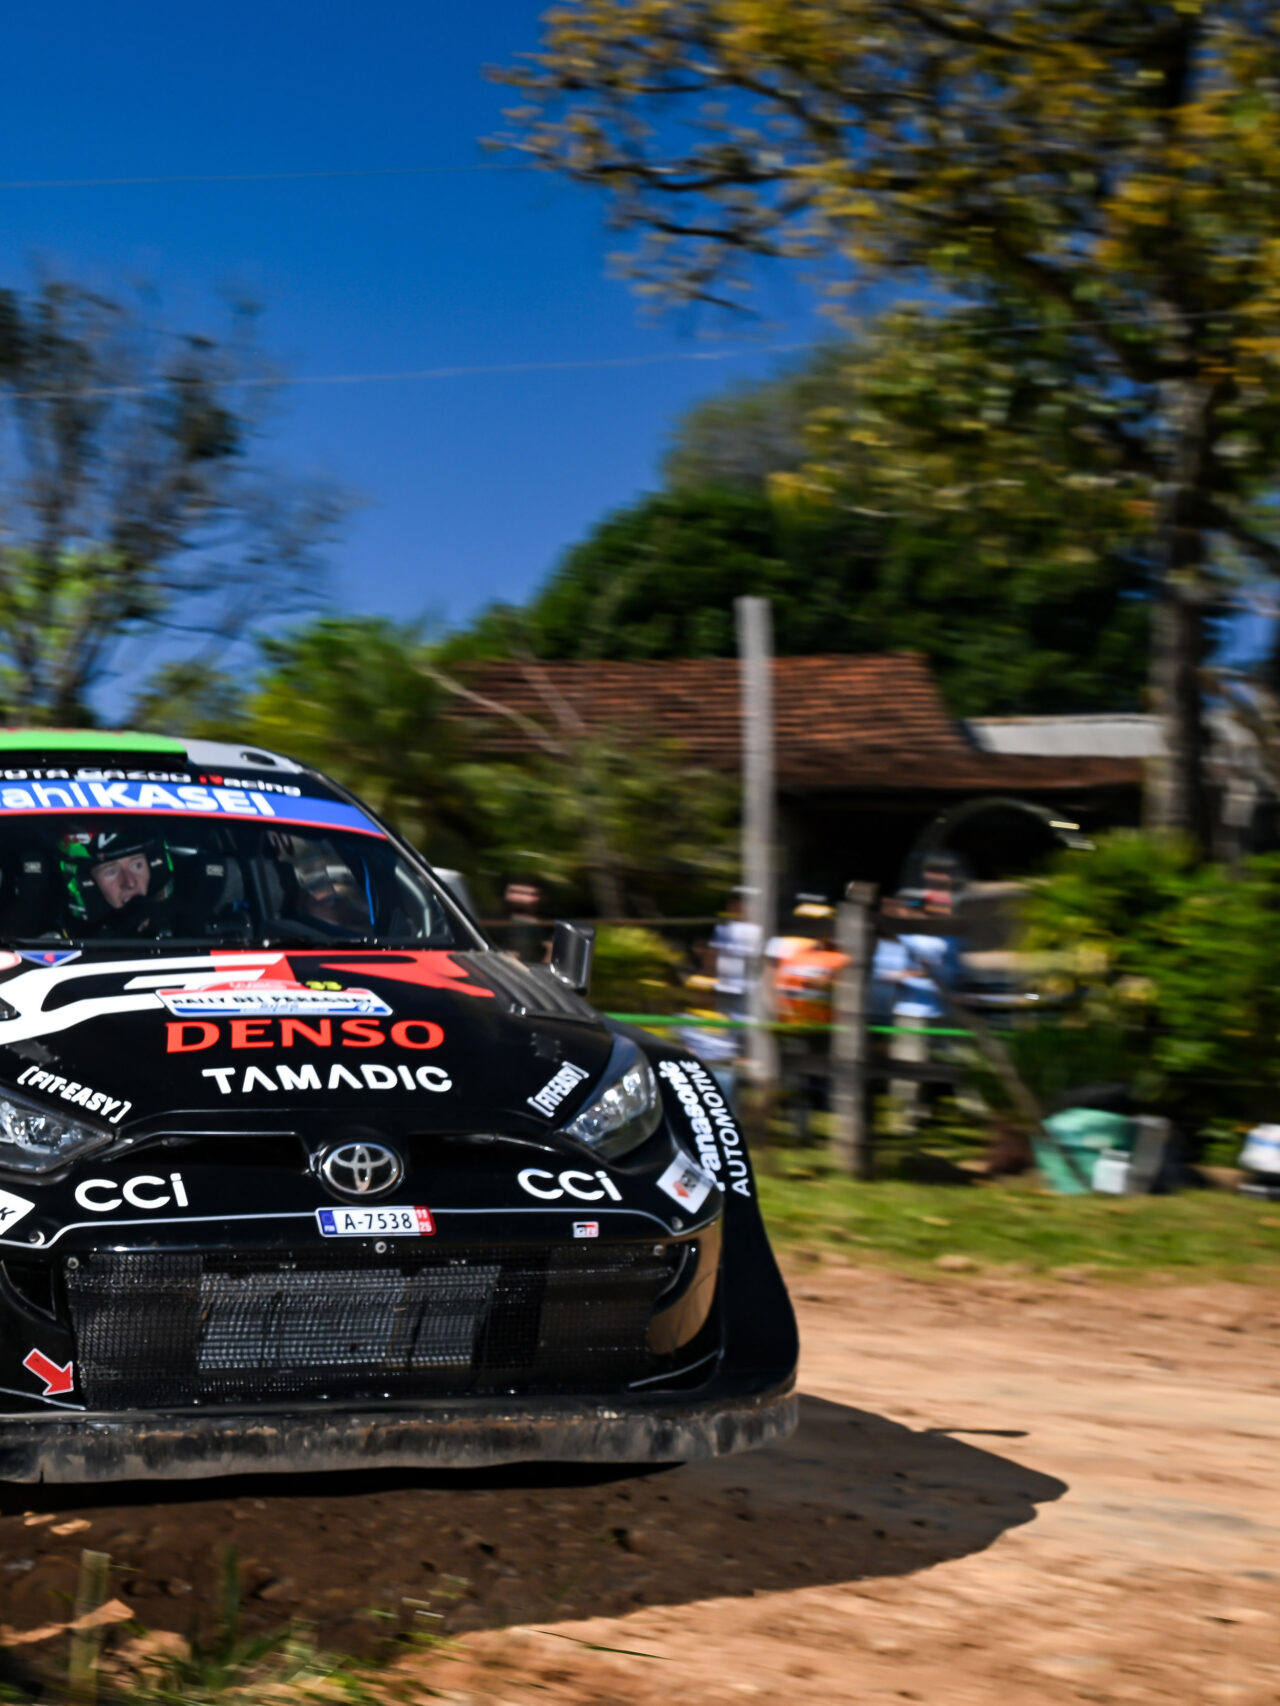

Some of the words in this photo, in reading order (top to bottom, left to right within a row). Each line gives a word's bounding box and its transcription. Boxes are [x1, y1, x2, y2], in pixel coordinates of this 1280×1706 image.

[165, 1018, 445, 1053] DENSO
[202, 1063, 453, 1094] TAMADIC
[678, 1060, 751, 1197] AUTOMOTIVE
[345, 1213, 413, 1230] A-7538
